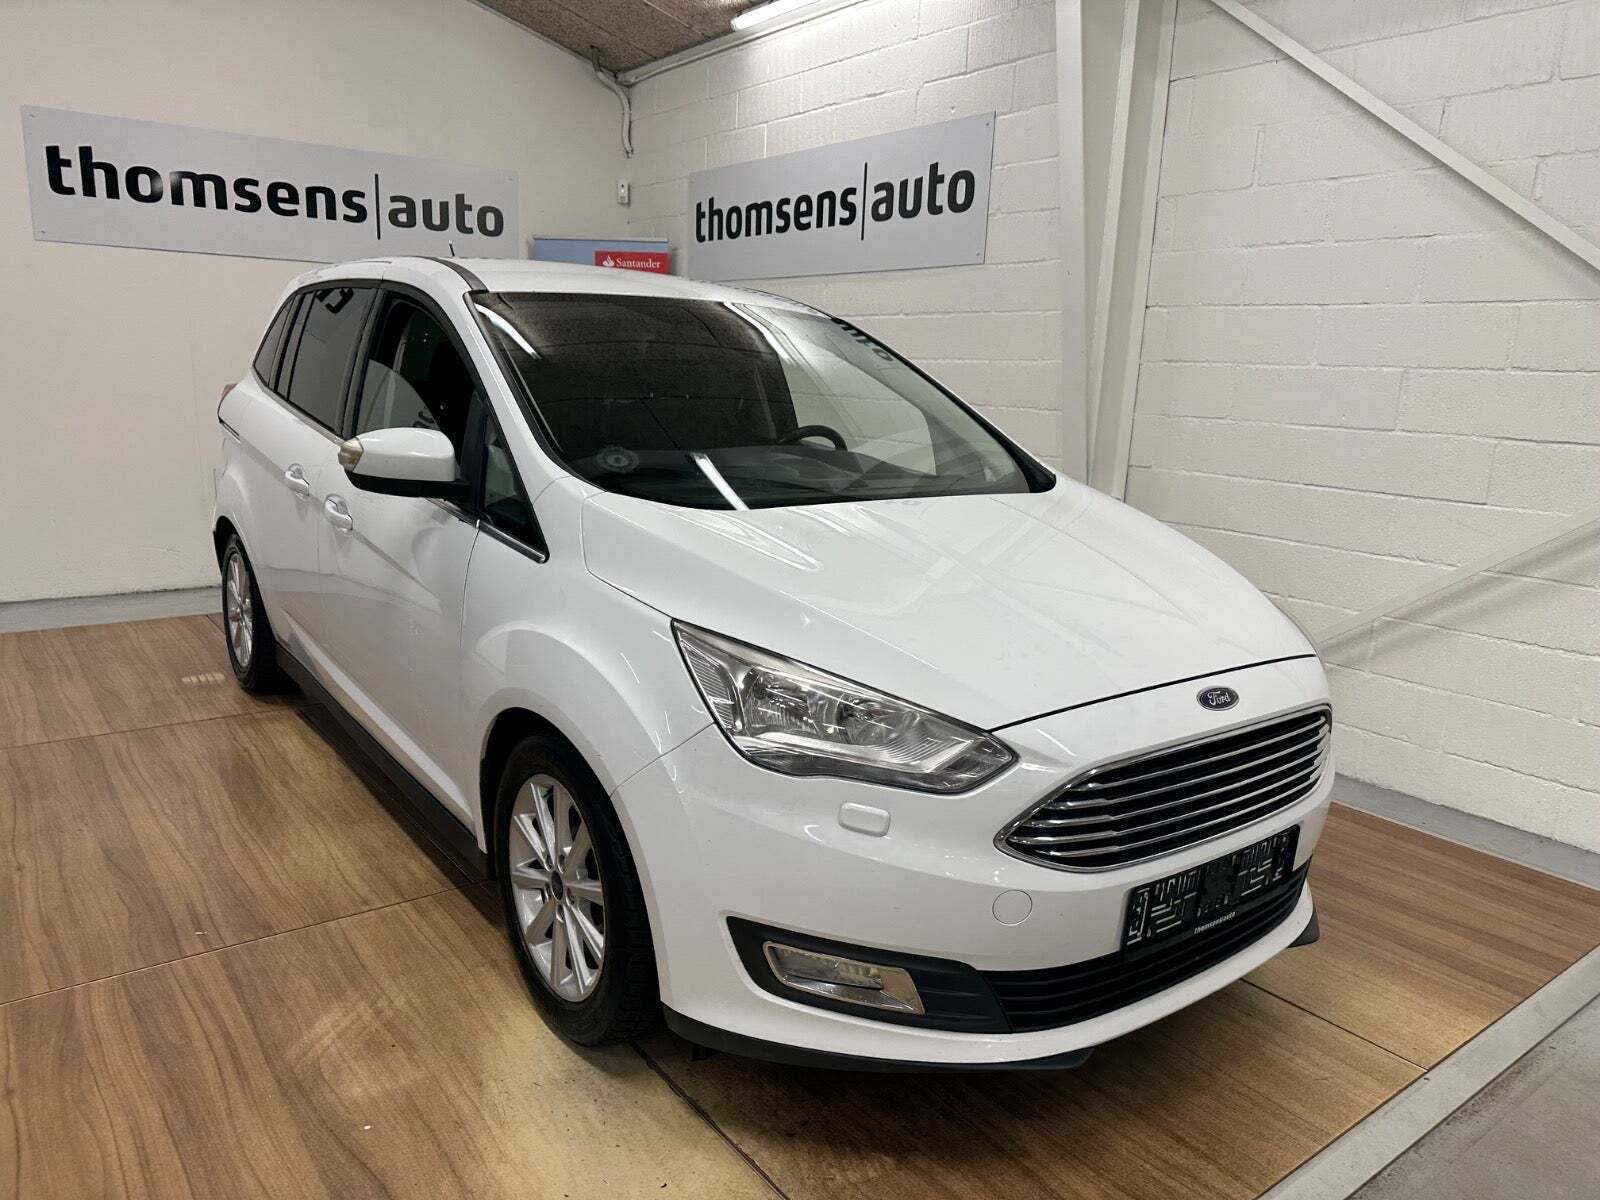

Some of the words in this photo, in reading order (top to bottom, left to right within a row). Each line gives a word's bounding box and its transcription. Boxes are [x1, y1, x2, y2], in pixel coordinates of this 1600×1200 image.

[46, 146, 367, 223] thomsens
[388, 194, 504, 238] auto
[695, 188, 858, 243] thomsens
[871, 161, 976, 223] auto
[616, 258, 661, 269] Santander
[1207, 690, 1231, 706] Ford
